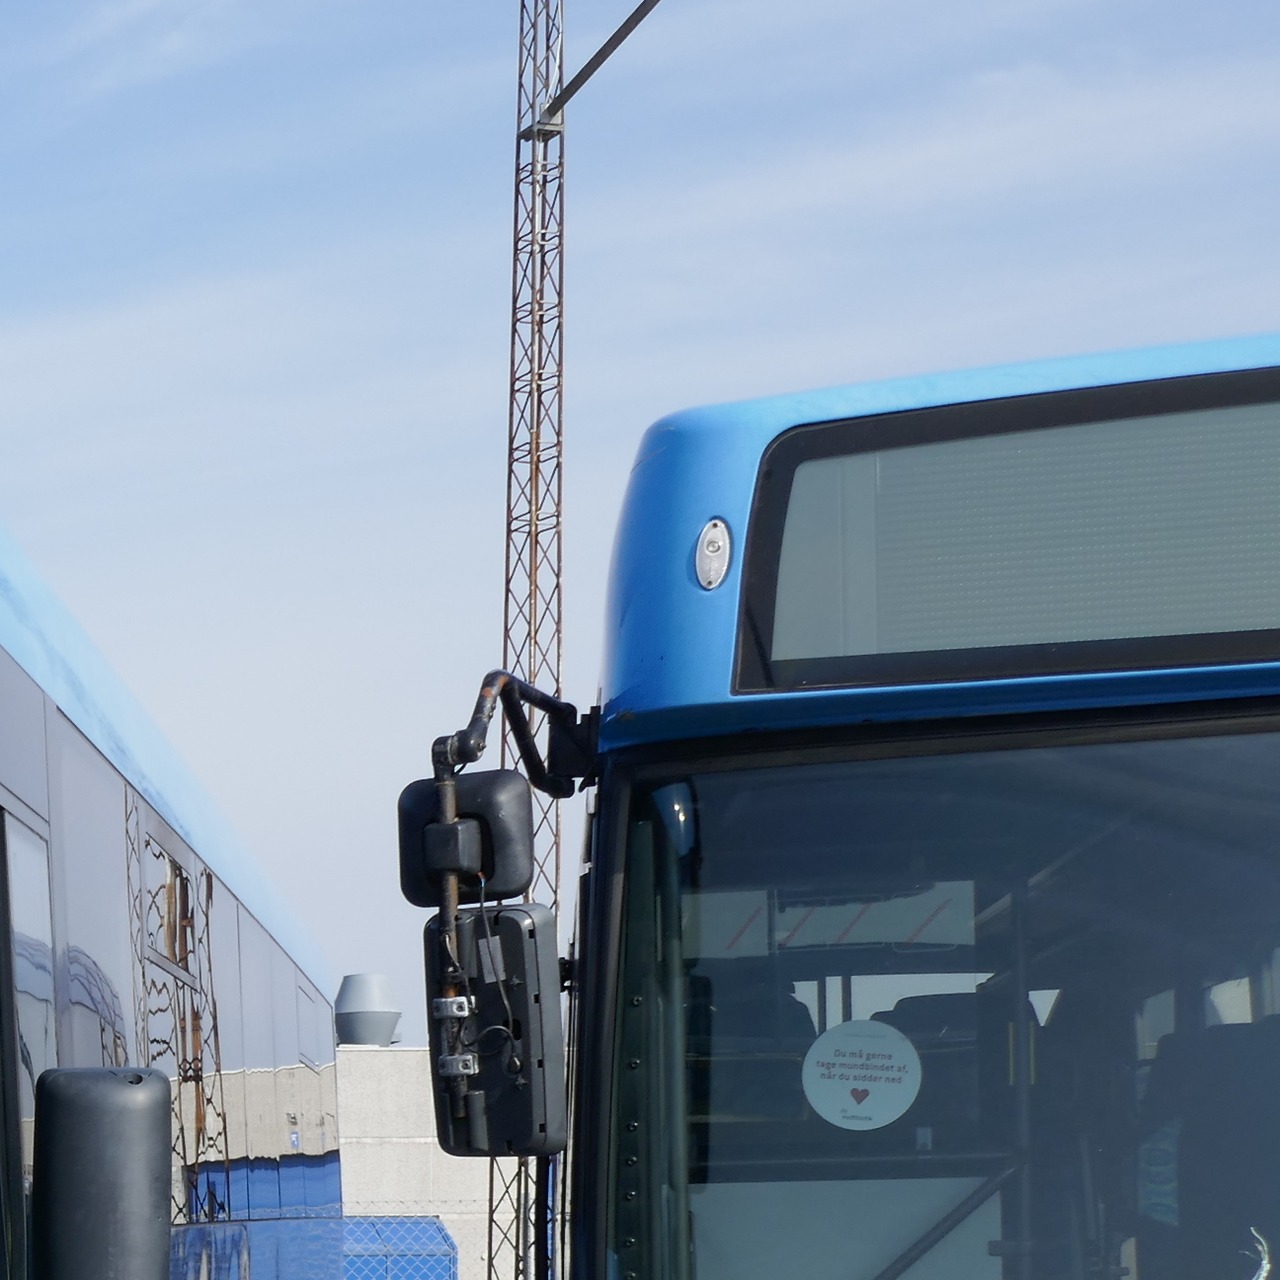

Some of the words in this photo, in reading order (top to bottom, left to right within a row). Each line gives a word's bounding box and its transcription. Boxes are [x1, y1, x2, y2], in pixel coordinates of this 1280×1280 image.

[833, 1049, 847, 1059] Du
[848, 1049, 863, 1060] må
[865, 1051, 893, 1062] gerne
[816, 1059, 837, 1071] tage
[838, 1061, 894, 1073] mundbindet
[820, 1071, 836, 1080] når
[839, 1072, 850, 1082] du
[852, 1073, 883, 1083] sidder
[884, 1075, 902, 1085] ned
